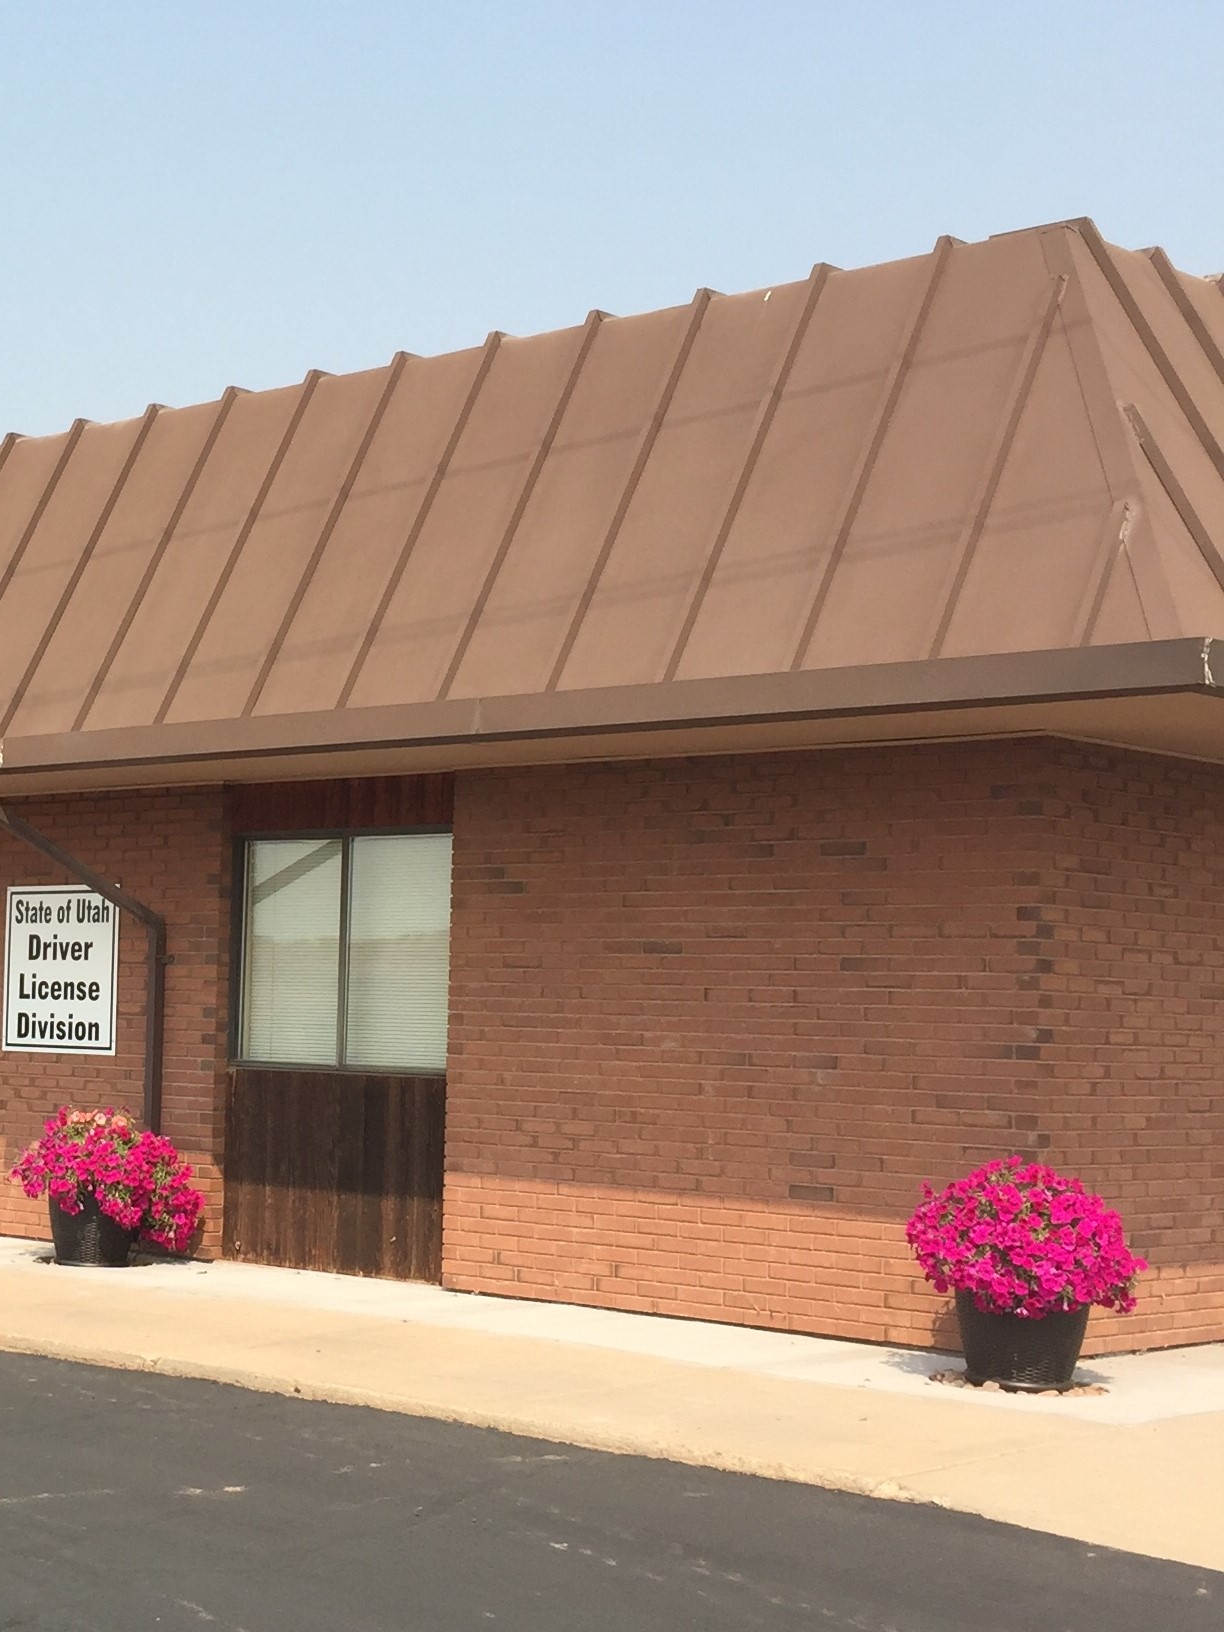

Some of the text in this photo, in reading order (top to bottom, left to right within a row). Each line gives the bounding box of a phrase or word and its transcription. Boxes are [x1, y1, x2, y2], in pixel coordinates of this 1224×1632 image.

[15, 898, 110, 924] State of Utah
[28, 934, 93, 961] Driver
[19, 973, 100, 1001] License
[17, 1012, 99, 1041] Division
